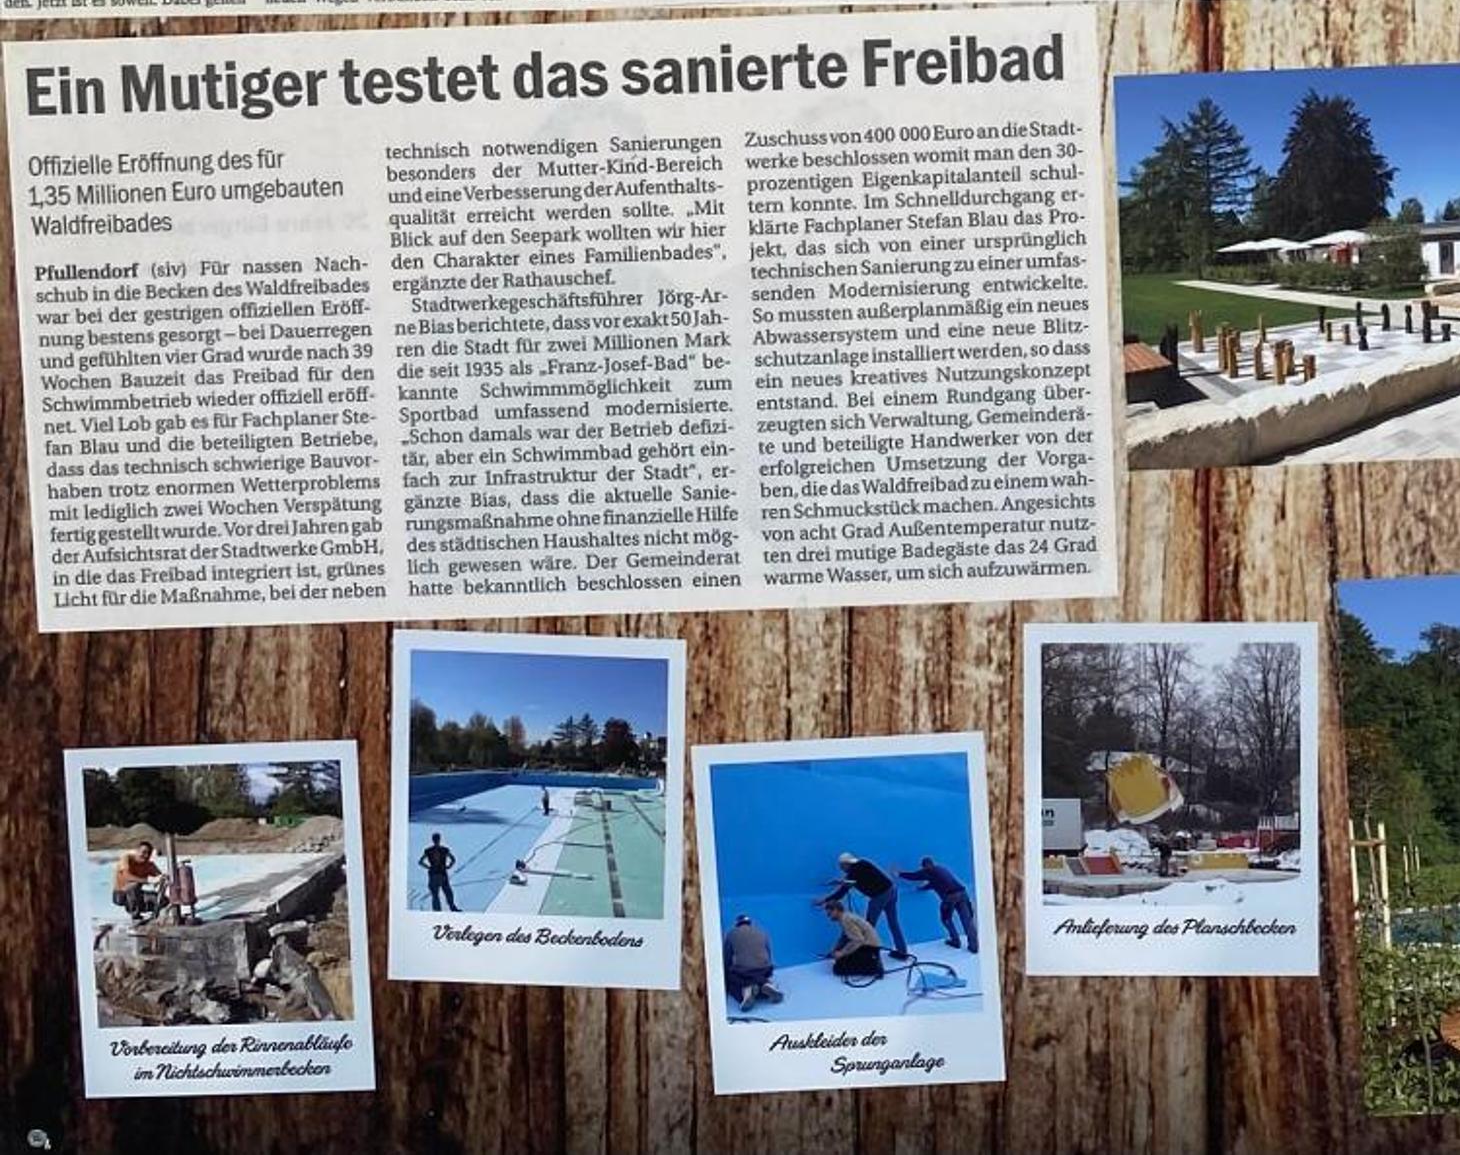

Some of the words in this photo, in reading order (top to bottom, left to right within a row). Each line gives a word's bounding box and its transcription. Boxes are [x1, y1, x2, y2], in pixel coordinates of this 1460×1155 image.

[25, 67, 105, 116] Ein
[120, 63, 327, 120] Mutiger
[338, 53, 501, 106] testet
[512, 50, 608, 99] das
[621, 42, 847, 96] sanierte
[862, 33, 1063, 87] Freibad
[27, 153, 112, 176] Offizielle
[117, 151, 214, 176] Eröffnung
[216, 149, 253, 170] des
[255, 148, 285, 169] für
[28, 184, 71, 209] 1,35
[76, 183, 166, 205] Millionen
[170, 180, 216, 202] Euro
[220, 177, 343, 203] umgebauten
[30, 212, 172, 236] Waldfreibades
[34, 262, 140, 281] Pfullendorf
[150, 261, 186, 279] (siv)
[199, 260, 230, 276] Für
[242, 260, 302, 274] nassen
[314, 256, 368, 272] Nach-
[762, 571, 824, 585] warme
[825, 566, 892, 583] Wasser,
[895, 567, 925, 580] um
[927, 562, 963, 579] sich
[966, 560, 1091, 578] aufzuwärmen.
[433, 924, 503, 947] Verlegen
[505, 926, 532, 943] des
[533, 927, 643, 947] Beckenbodens
[1052, 917, 1149, 939] Anlieferung
[1151, 917, 1180, 935] des
[1180, 917, 1297, 935] Planschbecken
[110, 1038, 207, 1059] Vorbereitung
[210, 1036, 238, 1054] der
[238, 1032, 353, 1054] Rinnenabläufe
[860, 1029, 888, 1046] der
[133, 1066, 154, 1080] im
[155, 1058, 331, 1080] Nichtschwimmerbecken
[829, 1051, 944, 1076] Sprunganlage
